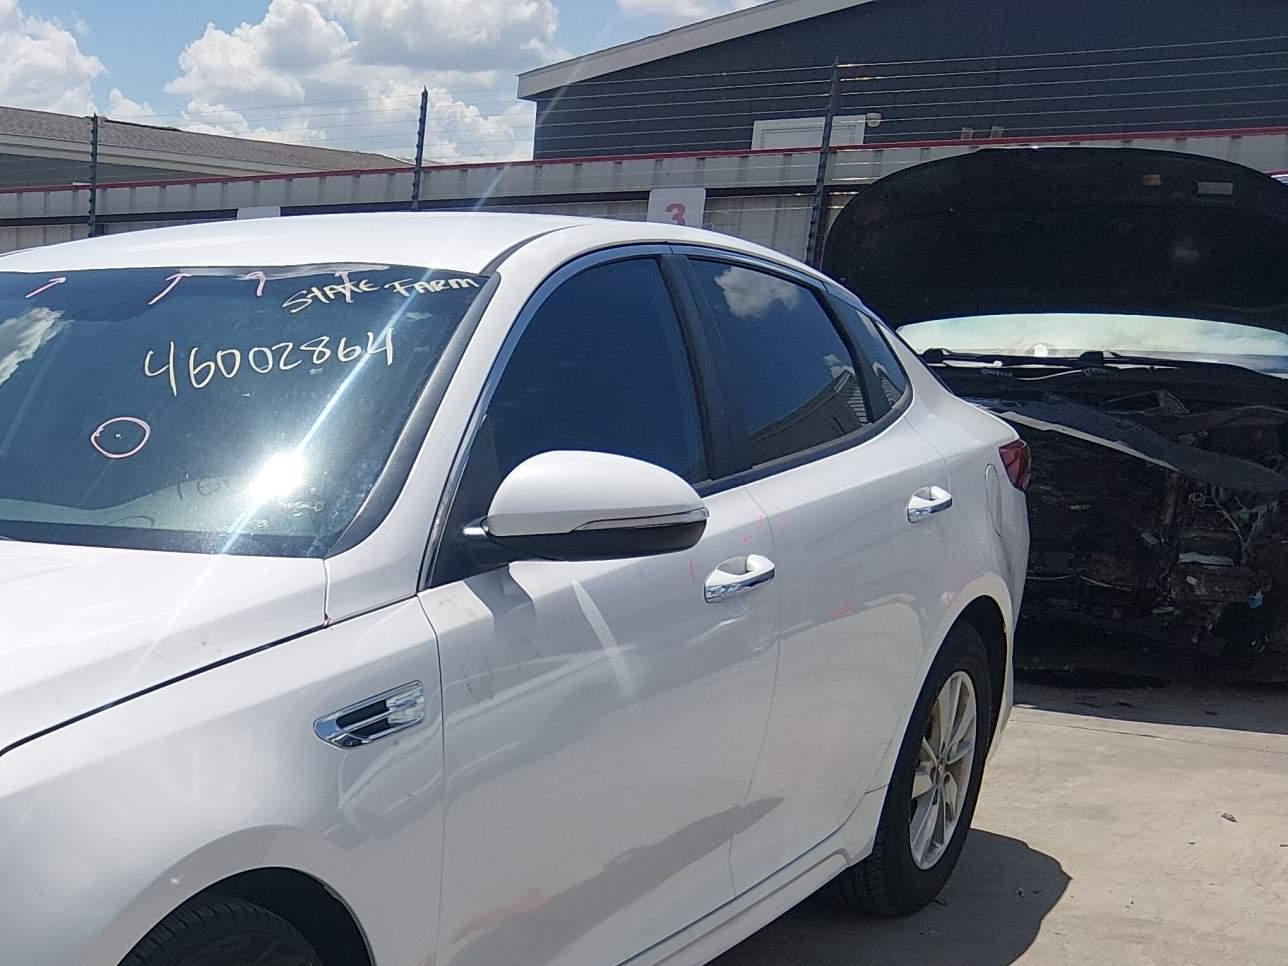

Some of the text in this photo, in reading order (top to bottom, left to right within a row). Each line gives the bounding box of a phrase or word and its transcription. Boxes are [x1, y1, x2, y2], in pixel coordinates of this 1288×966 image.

[665, 203, 686, 225] 3
[281, 277, 480, 314] STATE FARM
[143, 327, 394, 397] 46002864
